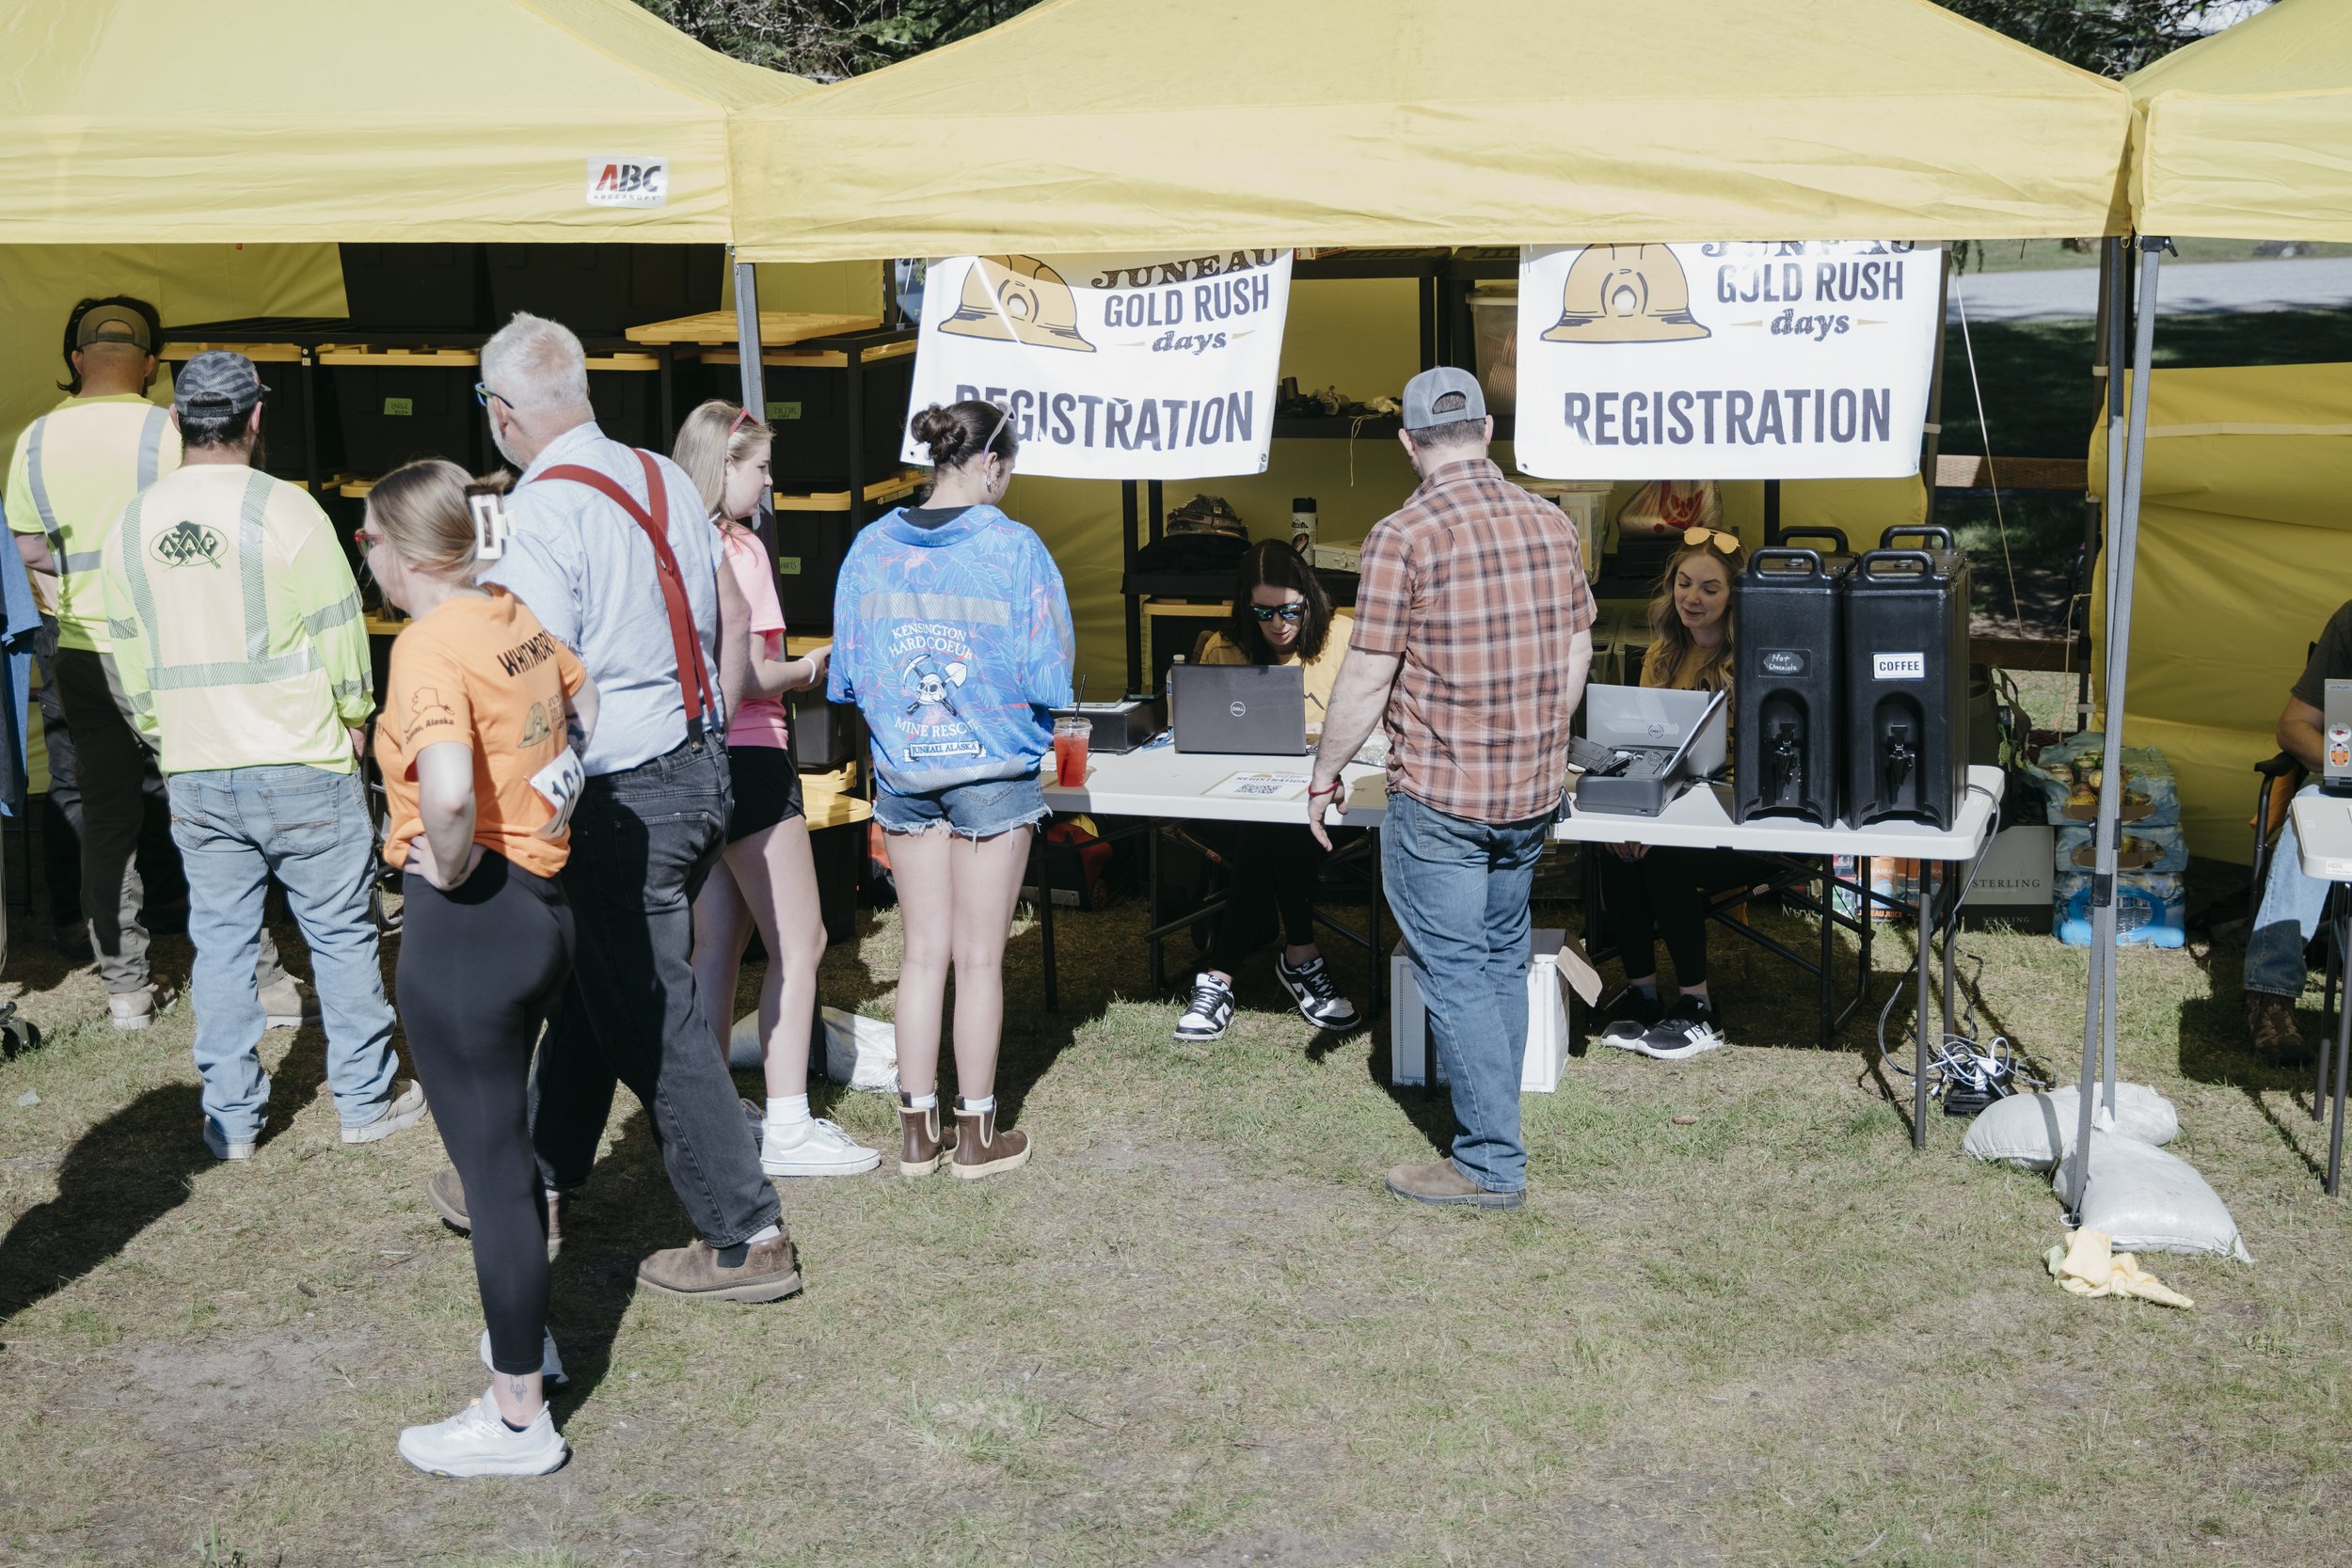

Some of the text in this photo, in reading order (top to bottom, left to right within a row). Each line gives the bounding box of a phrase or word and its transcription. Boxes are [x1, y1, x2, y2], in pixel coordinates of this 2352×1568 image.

[595, 164, 662, 193] ABC
[1090, 248, 1278, 289] JUNEAU
[1717, 261, 1904, 304] GOLD RUSH
[1104, 273, 1269, 328] GOLD RUSH
[1770, 308, 1851, 342] days
[1152, 329, 1228, 356] days
[955, 384, 1254, 451] GISTRATION
[1564, 388, 1891, 446] REGISTRATION
[163, 536, 215, 554] AAP
[892, 623, 967, 641] KENSINGTON
[1772, 654, 1791, 662] Hot
[1879, 660, 1920, 672] COFFEE
[425, 717, 454, 728] Alaska
[895, 717, 929, 737] MINE
[945, 742, 977, 752] ALASKA
[1972, 878, 2041, 889] STERLING
